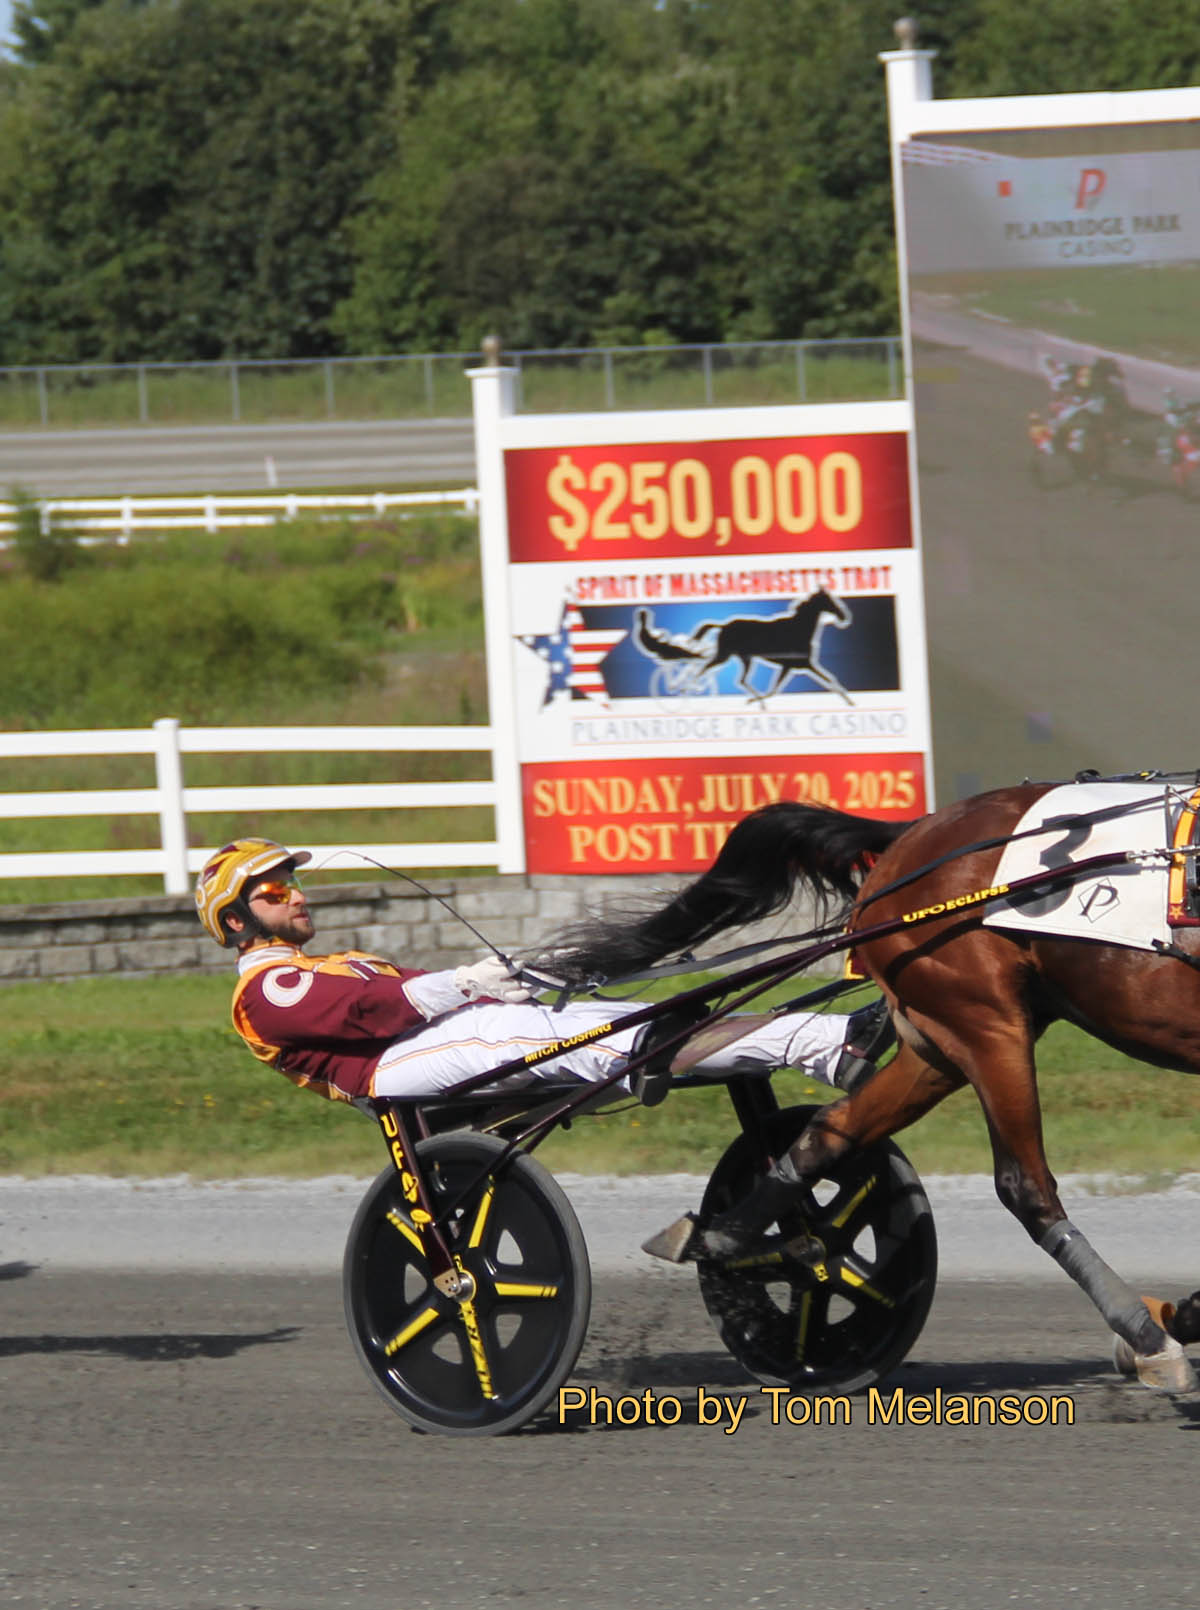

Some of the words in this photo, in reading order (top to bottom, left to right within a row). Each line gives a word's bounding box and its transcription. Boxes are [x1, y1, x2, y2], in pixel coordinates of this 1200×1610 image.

[1003, 218, 1124, 240] PLAINRIDGE
[1131, 213, 1182, 234] PARK
[1059, 236, 1137, 259] CASINO
[546, 452, 863, 550] $250,000
[576, 575, 638, 600] SPIRIT
[643, 574, 663, 598] OF
[669, 569, 837, 597] MASSACHUSETTS
[840, 565, 892, 591] TROT
[572, 718, 721, 742] PLAINRIDGE
[733, 715, 799, 738] PARK
[808, 712, 907, 736] CASINO
[533, 776, 693, 819] SUNDAY,
[699, 772, 787, 812] JULY
[844, 770, 916, 809] 2025
[569, 823, 678, 863] POST
[946, 885, 1009, 910] ECLIPSE
[525, 1041, 560, 1063] MITCH
[562, 1022, 612, 1048] CUSHING
